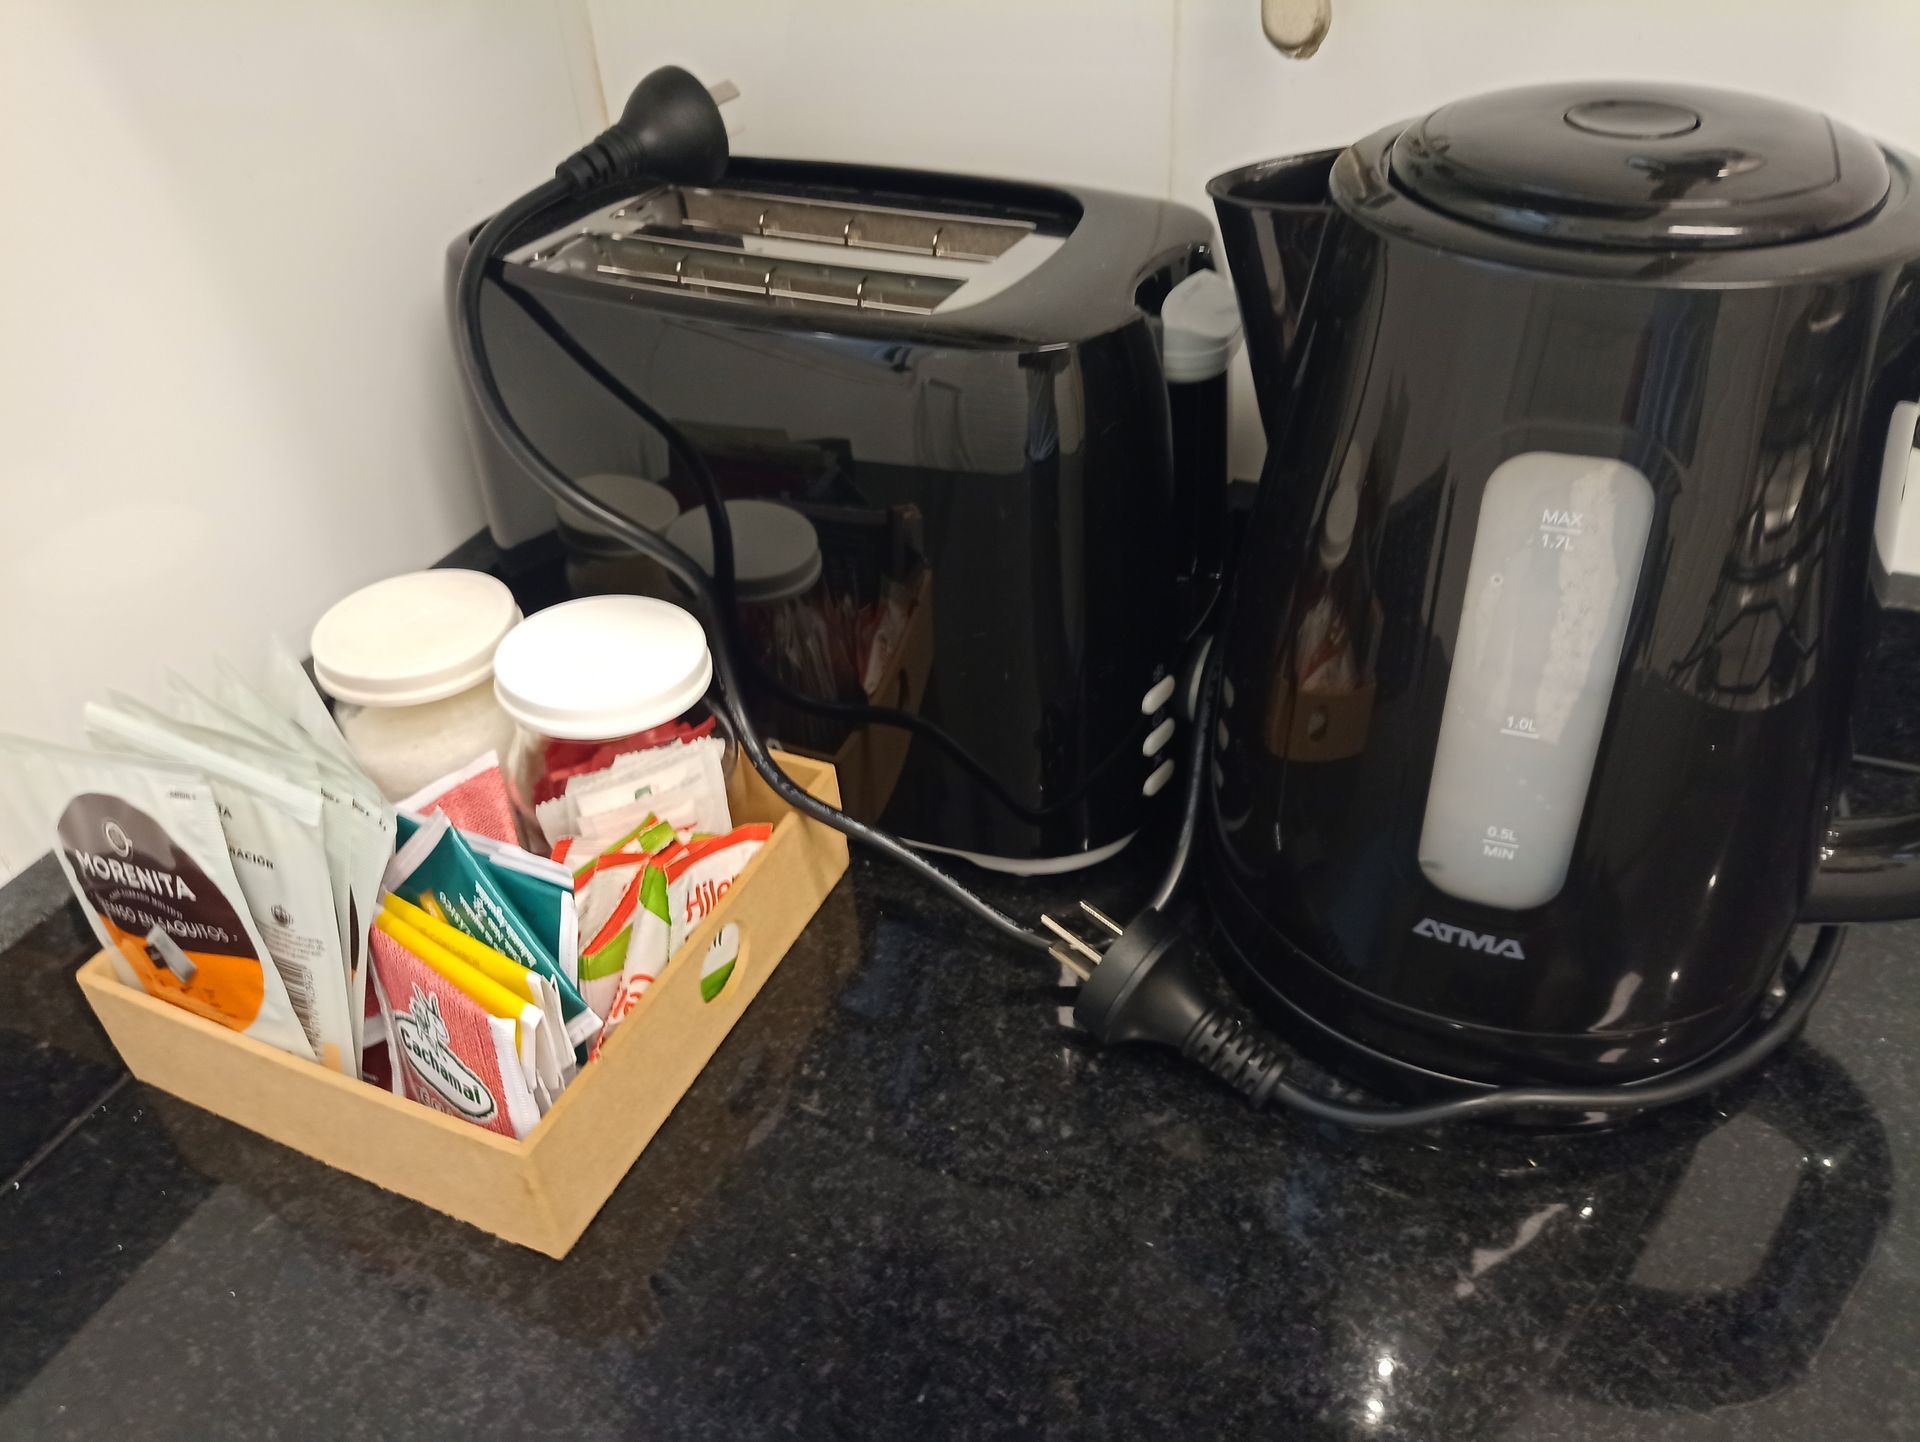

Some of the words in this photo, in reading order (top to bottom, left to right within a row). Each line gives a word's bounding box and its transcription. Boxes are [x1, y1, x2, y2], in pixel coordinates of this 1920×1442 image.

[1541, 509, 1583, 527] MAX
[1541, 534, 1574, 551] 1.7L
[1507, 715, 1536, 732] 1.0L
[1487, 825, 1518, 842] 0.5L
[1483, 844, 1514, 860] MIN
[75, 849, 197, 902] MORENITA
[686, 873, 737, 923] Hile
[1412, 917, 1525, 960] ATMA
